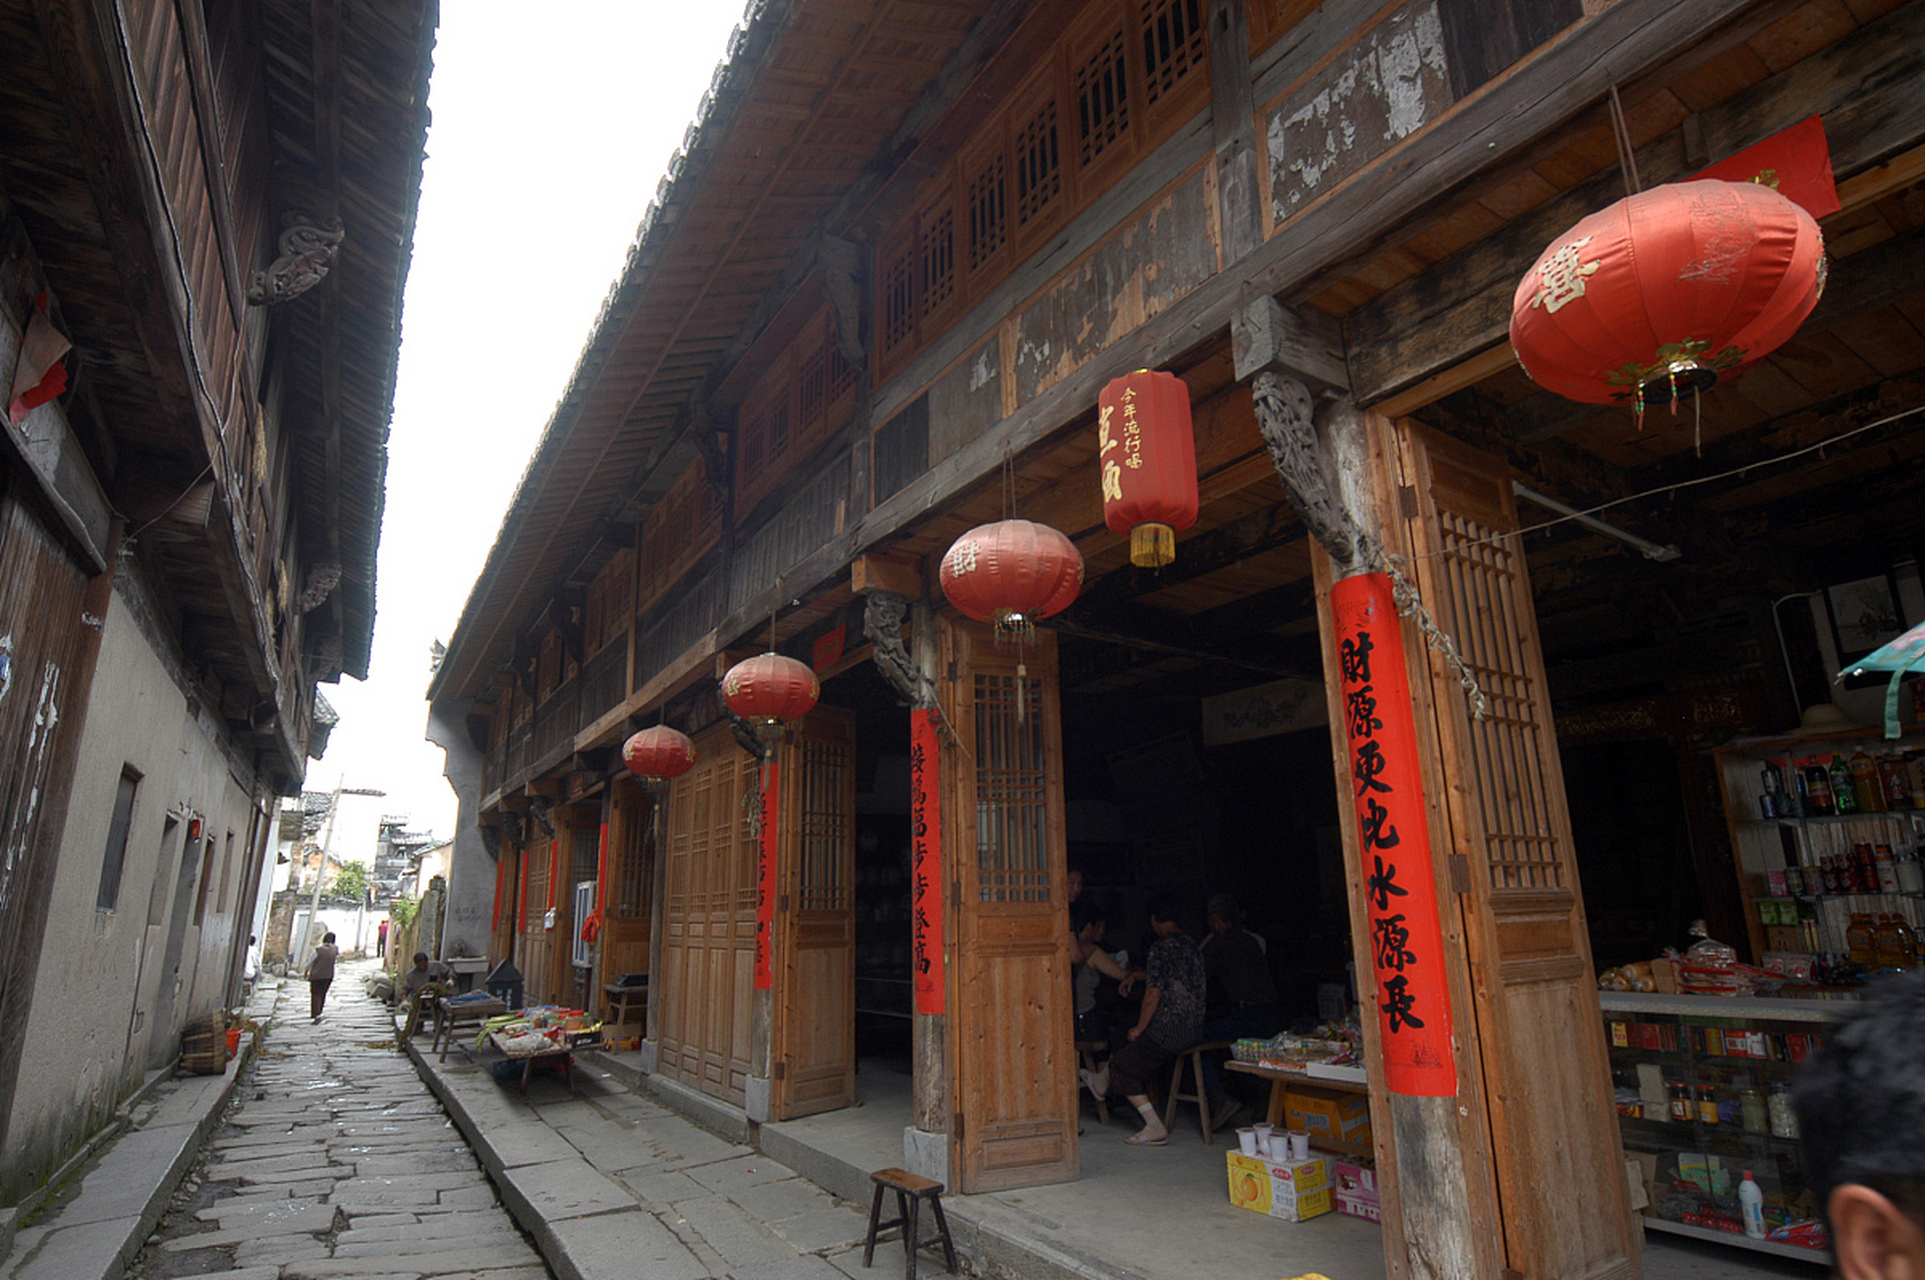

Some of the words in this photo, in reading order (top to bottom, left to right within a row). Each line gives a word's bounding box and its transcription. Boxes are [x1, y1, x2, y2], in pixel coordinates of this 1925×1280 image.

[1120, 386, 1143, 470] 今年流行喝
[1339, 631, 1425, 1034] 財源更比水源長
